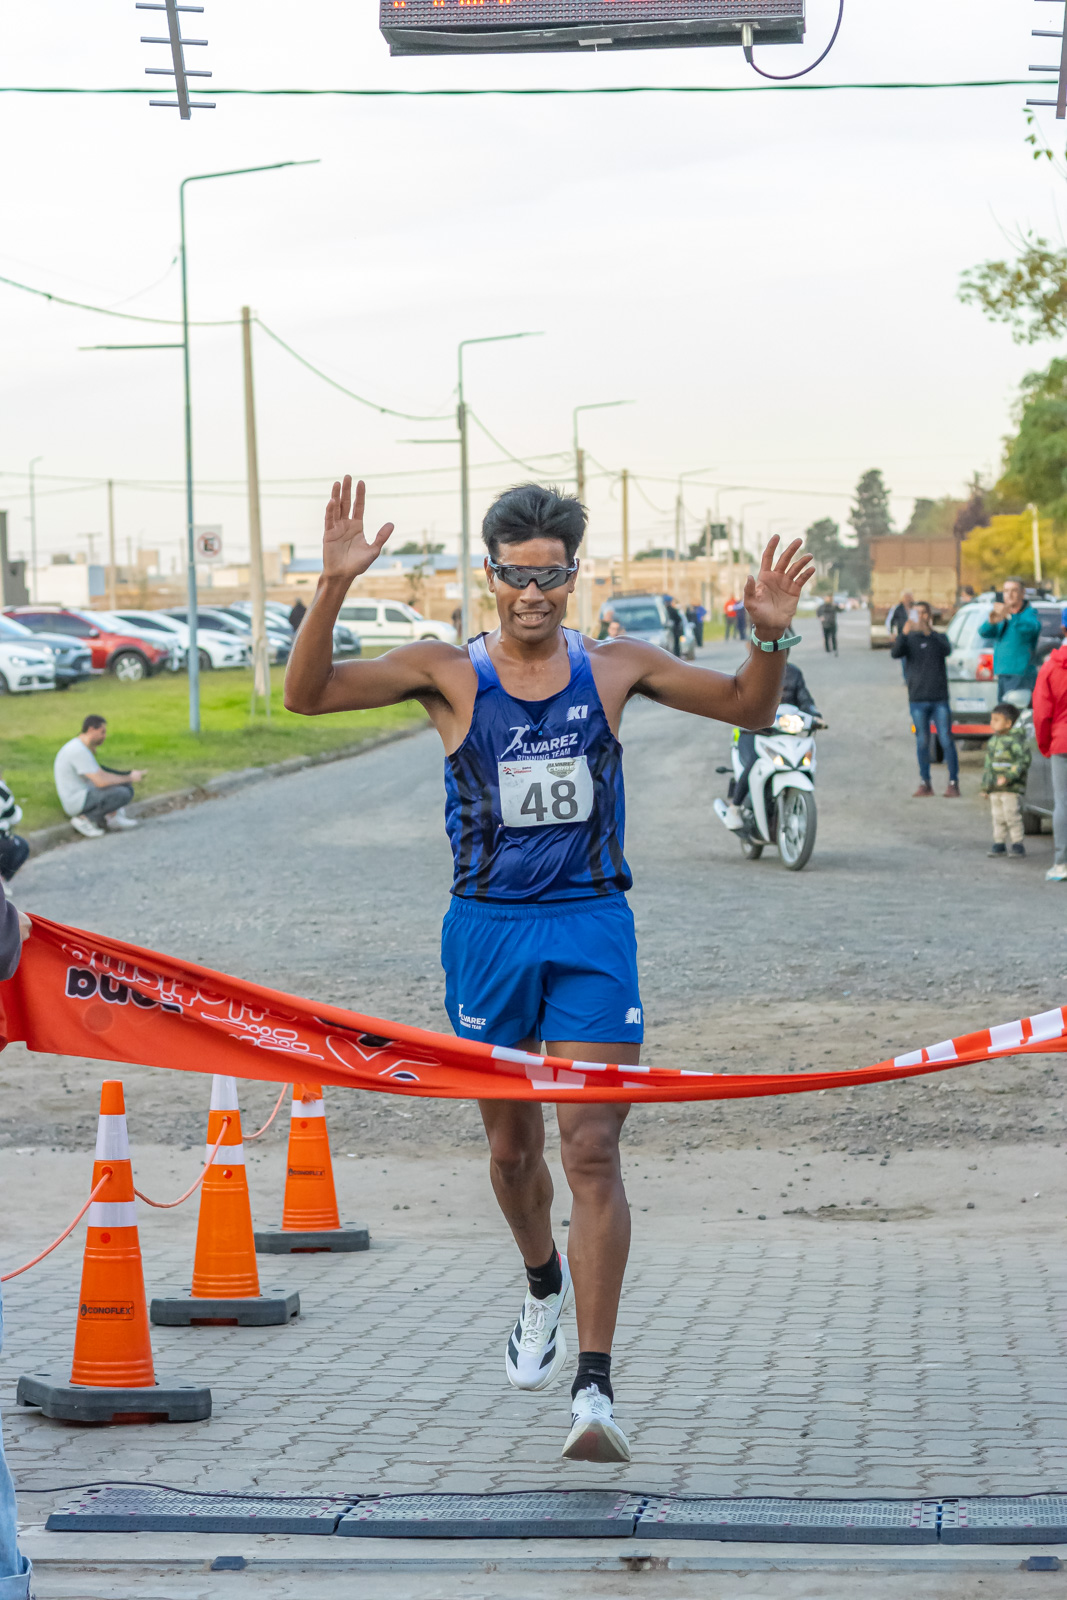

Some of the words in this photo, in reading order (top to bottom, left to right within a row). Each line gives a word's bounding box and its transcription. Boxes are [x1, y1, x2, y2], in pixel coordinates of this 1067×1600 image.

[551, 748, 571, 758] TEAM
[520, 779, 578, 822] 48
[87, 1306, 131, 1315] CONOFLEX
